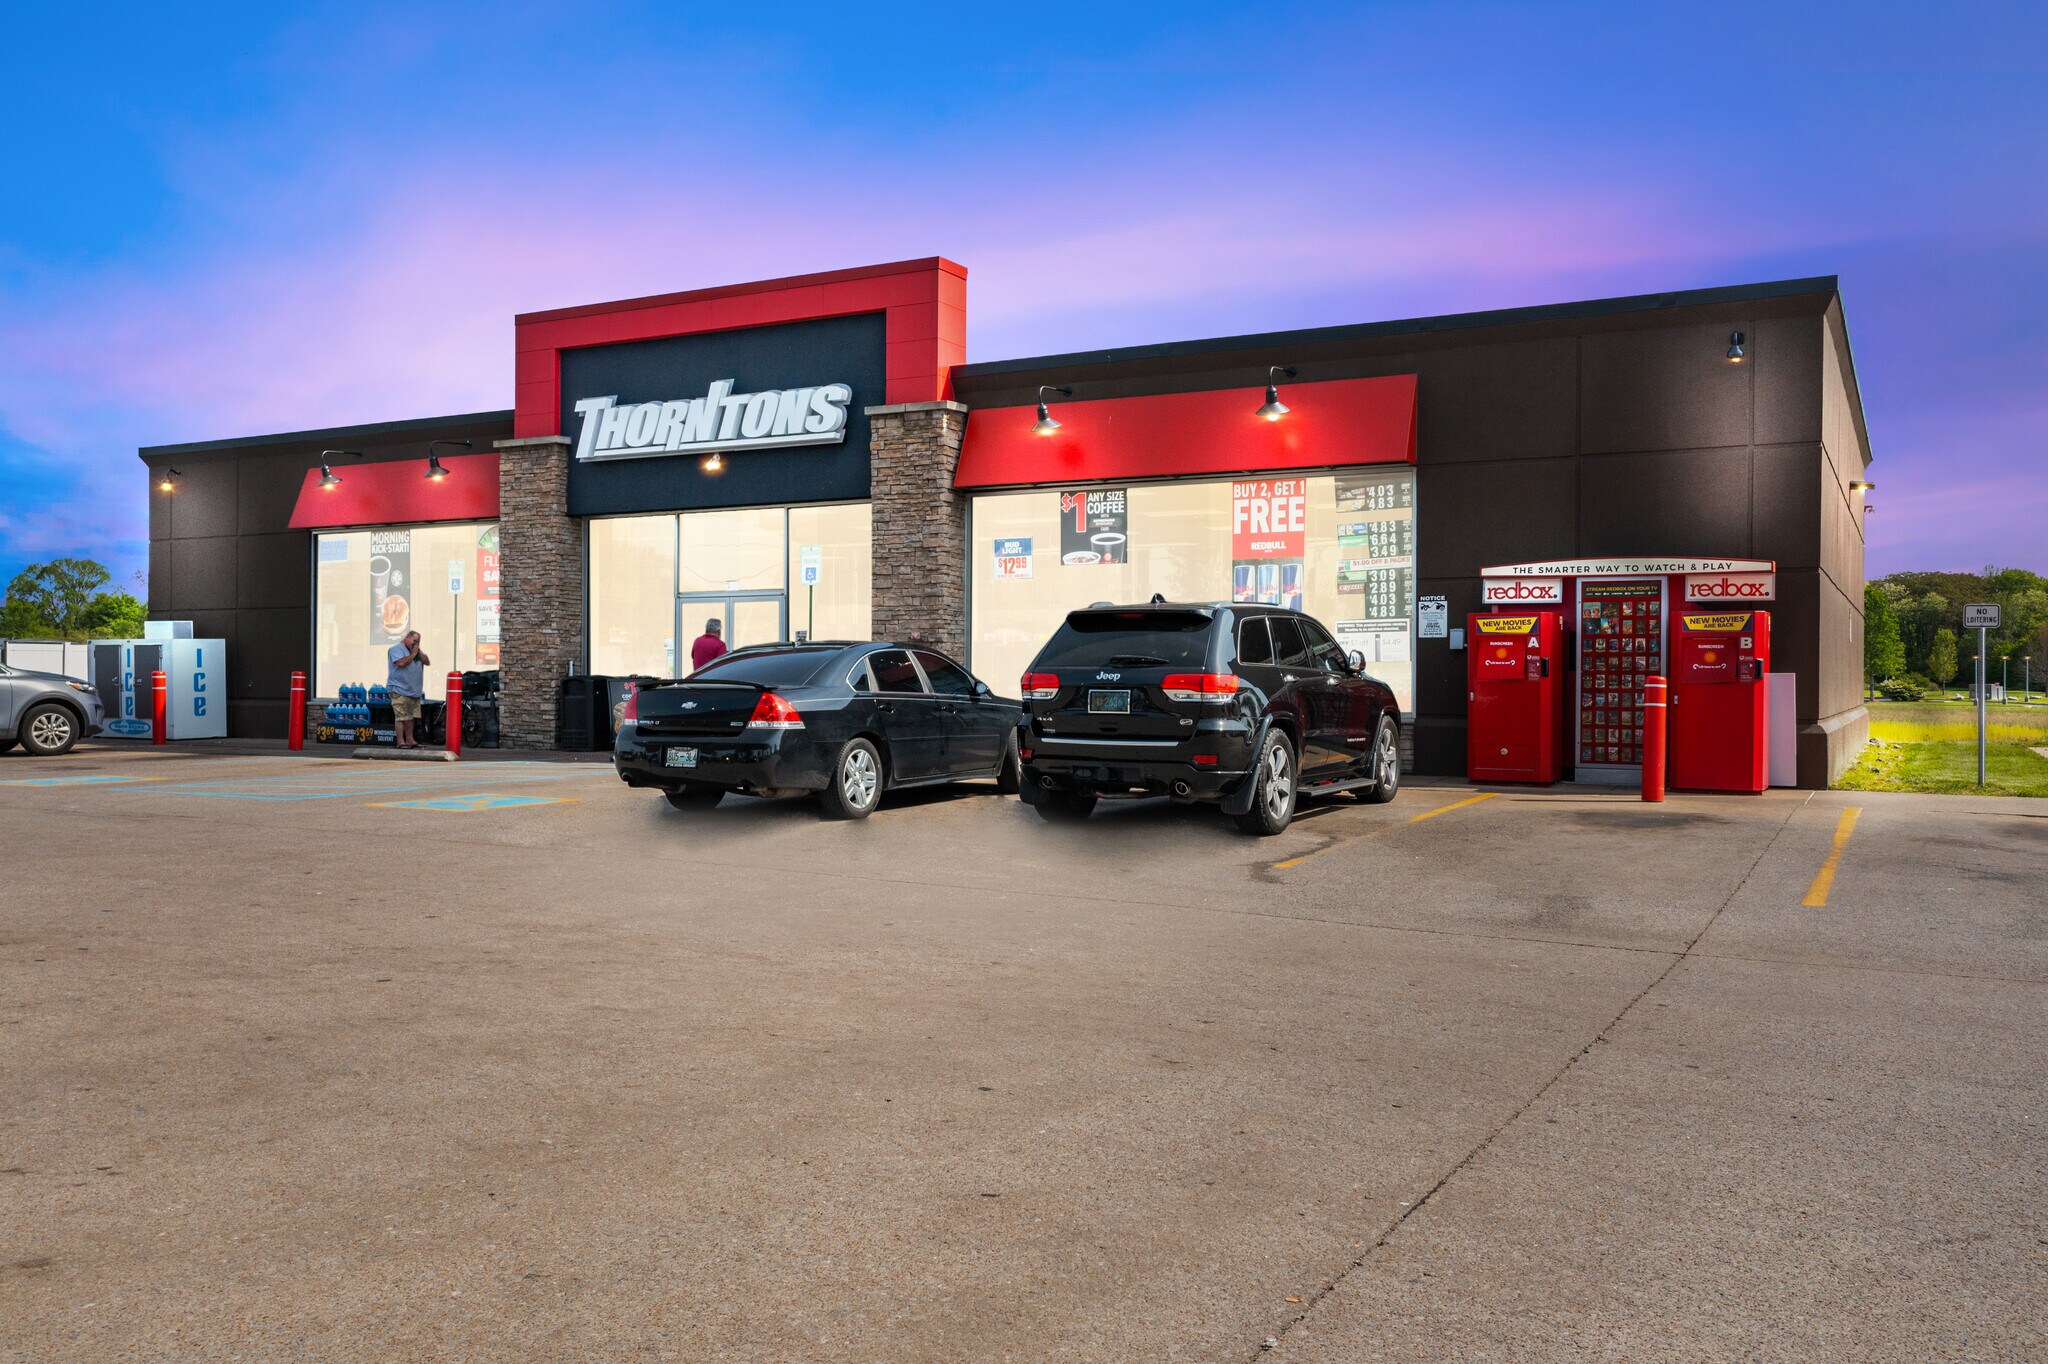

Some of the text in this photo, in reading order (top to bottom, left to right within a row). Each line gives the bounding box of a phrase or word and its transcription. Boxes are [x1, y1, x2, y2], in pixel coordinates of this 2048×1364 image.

[574, 378, 852, 462] THORNTONS
[1233, 483, 1257, 499] BUY
[1274, 481, 1296, 496] GET
[1300, 480, 1305, 495] 1
[1087, 491, 1125, 502] ANY SIZE
[1061, 492, 1087, 533] $1
[1087, 501, 1125, 514] COFFEE
[1233, 496, 1305, 534] FREE
[371, 531, 410, 544] MORNING
[371, 543, 410, 554] KICK-START!
[1251, 541, 1287, 550] REDBULL
[1595, 565, 1621, 573] WAY
[1625, 564, 1639, 572] TO
[1644, 563, 1685, 571] WATCH
[1690, 563, 1697, 571] &
[1702, 562, 1733, 570] PLAY
[1527, 637, 1539, 647] A
[1740, 637, 1753, 648] B
[1096, 671, 1121, 681] Jeep
